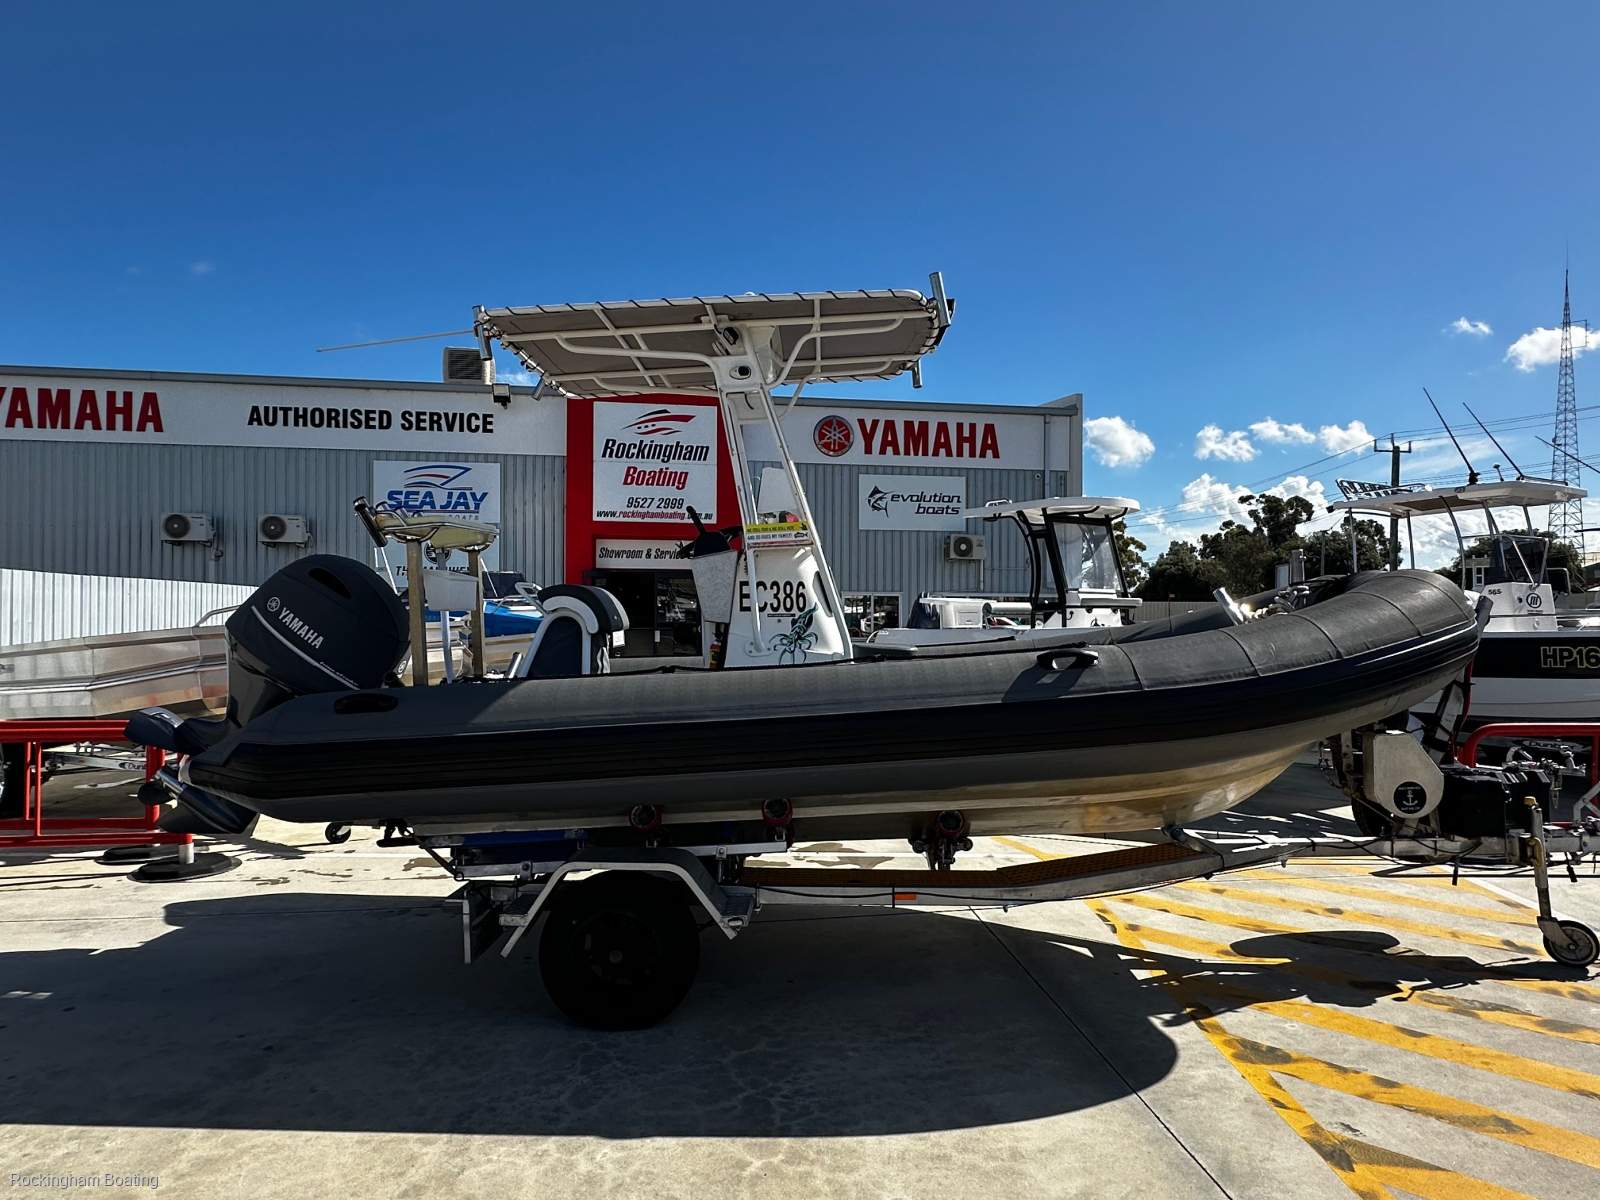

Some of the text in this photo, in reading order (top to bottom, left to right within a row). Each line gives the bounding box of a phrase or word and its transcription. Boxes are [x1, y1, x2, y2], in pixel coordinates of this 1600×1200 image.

[0, 387, 163, 432] AMAHA
[248, 405, 494, 433] AUTHORISED SERVICE
[601, 438, 710, 463] Rockingham
[856, 418, 1000, 459] YAMAHA
[622, 466, 689, 490] Boating
[387, 490, 488, 511] SEA JAY
[626, 496, 684, 509] 9527 2999
[890, 491, 962, 503] evolution
[914, 503, 961, 515] boats
[596, 510, 713, 520] www.rockinghamboating.cm.au
[599, 546, 643, 559] Showroom
[645, 548, 652, 559] &
[739, 580, 807, 613] EC386
[278, 607, 324, 649] YAMAHA
